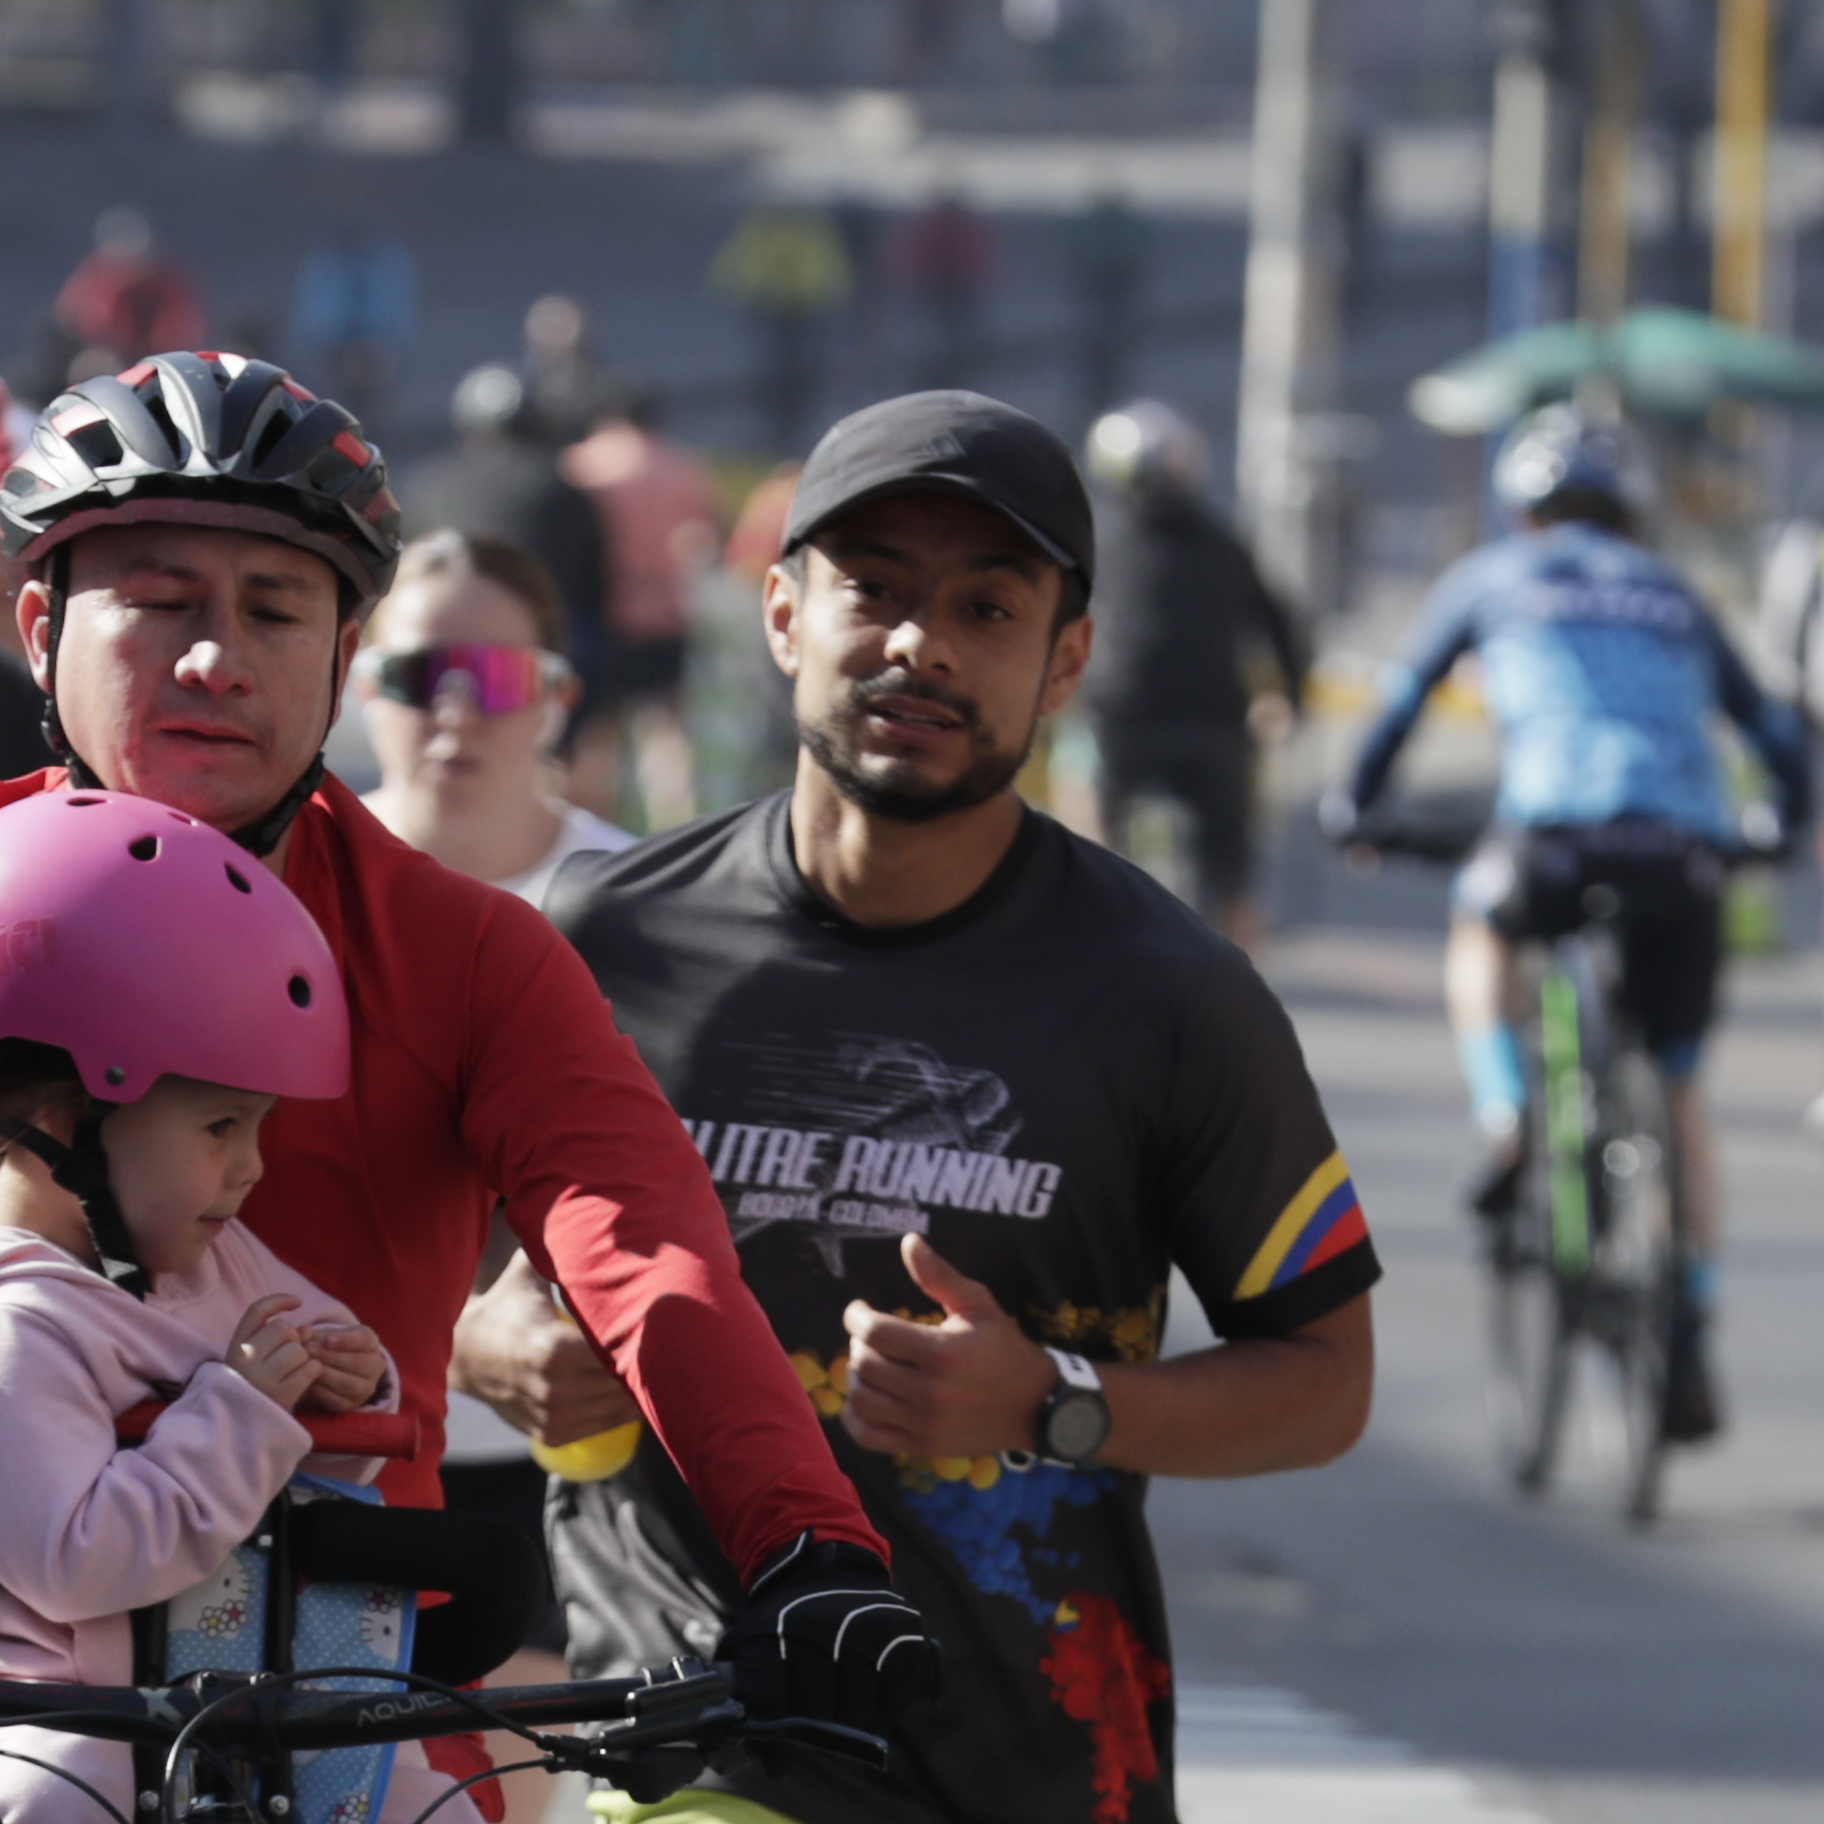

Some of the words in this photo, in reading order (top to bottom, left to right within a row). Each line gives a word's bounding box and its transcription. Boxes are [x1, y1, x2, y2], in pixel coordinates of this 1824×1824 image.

[682, 1118, 833, 1187] LITRE
[836, 1136, 1062, 1219] RUNNING
[830, 1200, 931, 1234] COLOMBIA
[355, 1693, 453, 1729] AQUIL
